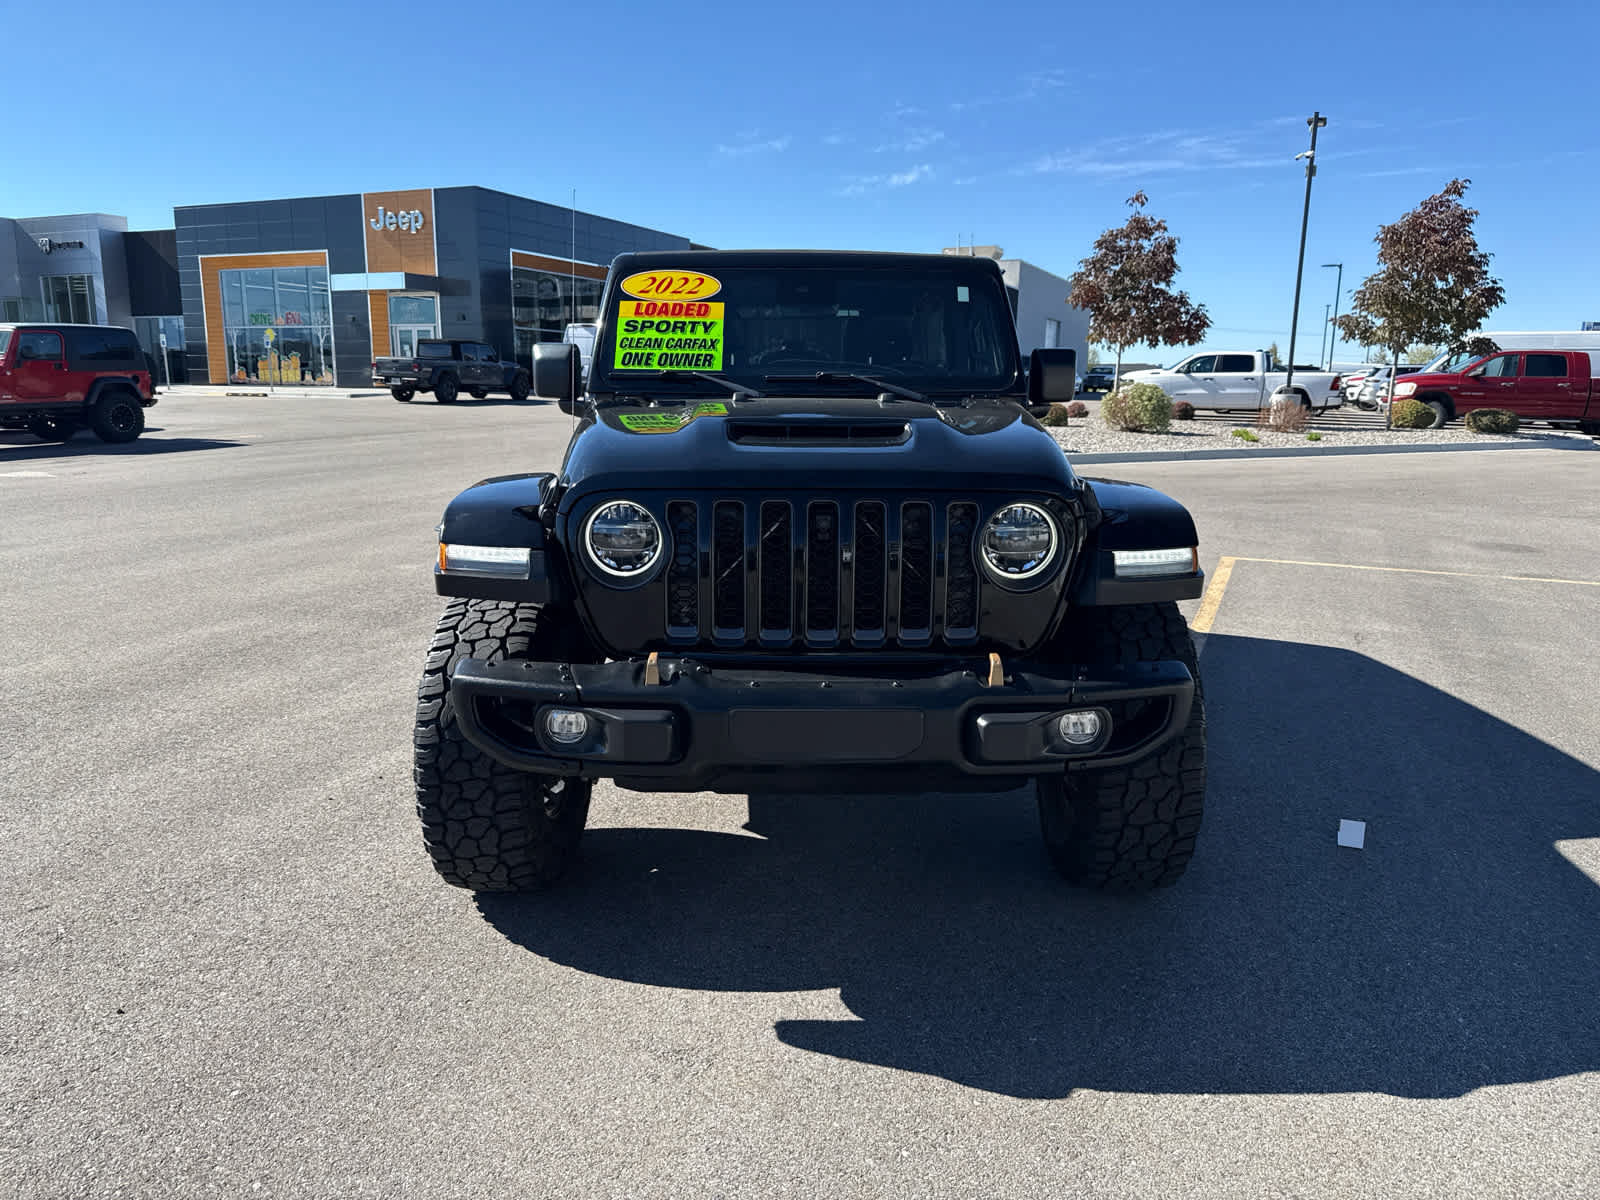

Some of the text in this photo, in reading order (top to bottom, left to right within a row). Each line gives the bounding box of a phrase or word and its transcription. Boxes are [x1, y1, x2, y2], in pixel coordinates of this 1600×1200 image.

[370, 206, 424, 234] Jeep
[637, 276, 705, 295] 2022
[633, 302, 711, 317] LOADED
[623, 319, 717, 334] SPORTY
[619, 337, 719, 351] CLEAN CARFAX
[621, 351, 715, 368] ONE OWNER
